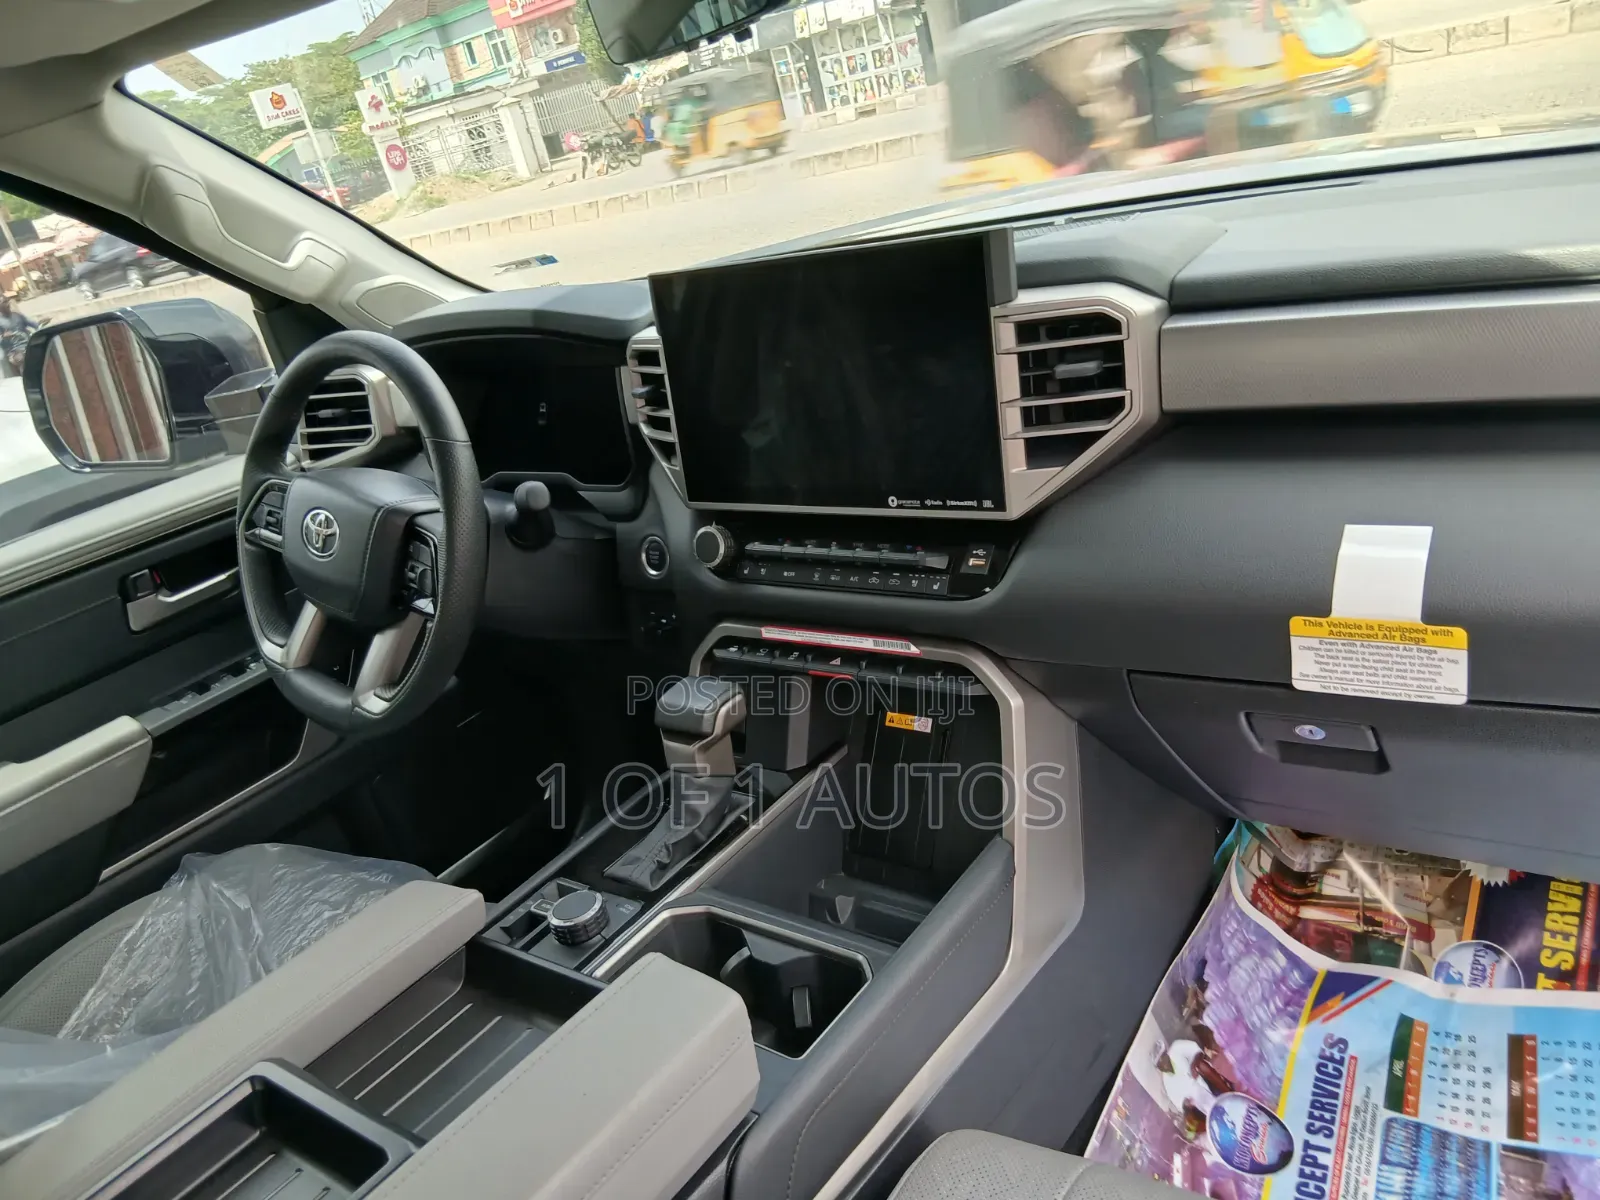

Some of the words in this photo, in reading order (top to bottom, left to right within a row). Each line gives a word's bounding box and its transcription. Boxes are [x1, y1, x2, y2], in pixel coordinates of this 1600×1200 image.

[1302, 618, 1323, 627] This
[1325, 620, 1362, 630] Vehicle
[1377, 623, 1427, 637] Equipped
[1430, 628, 1453, 637] with
[1327, 628, 1377, 640] Advanced
[1381, 632, 1397, 641] Air
[1400, 633, 1426, 644] Bags
[1359, 642, 1400, 651] Advanced
[1416, 647, 1437, 655] Bags
[1540, 877, 1584, 971] SERVI
[1305, 1032, 1349, 1138] SERVICES
[1294, 1139, 1332, 1200] CEPT
